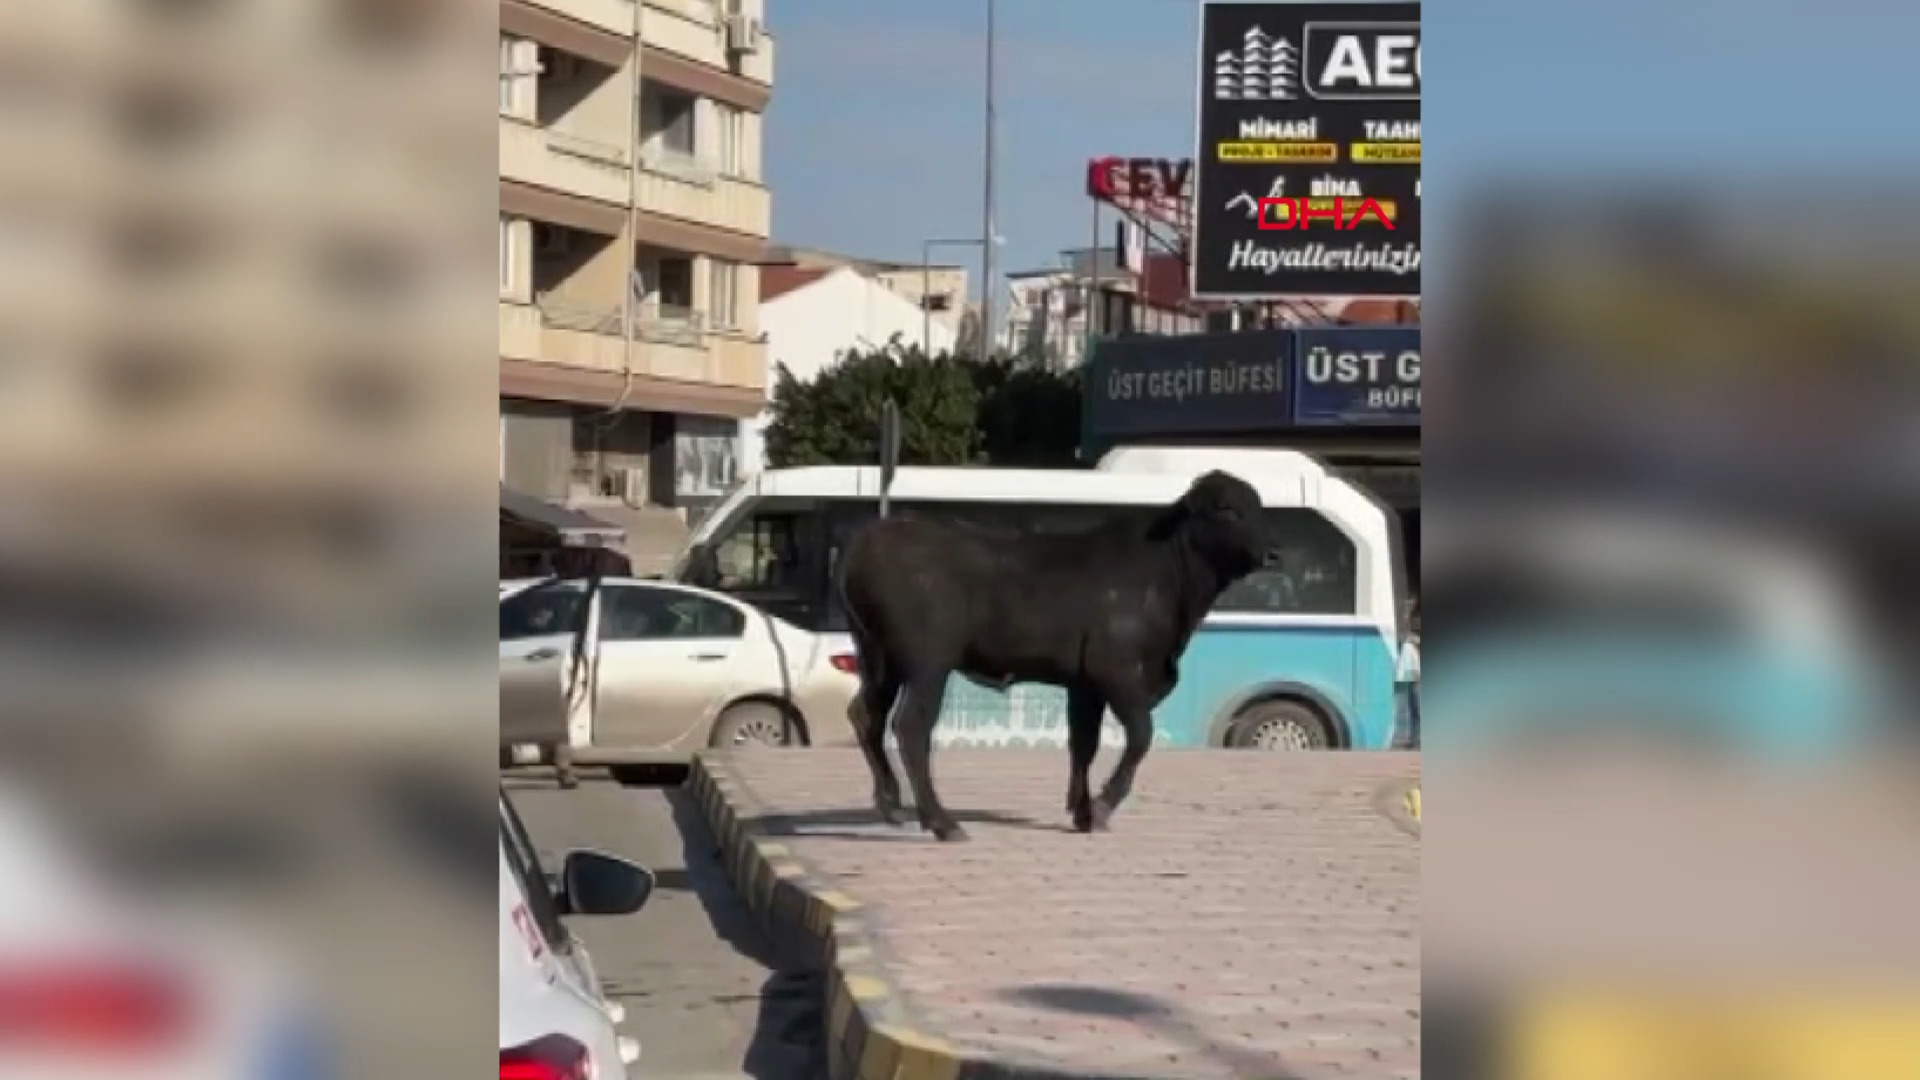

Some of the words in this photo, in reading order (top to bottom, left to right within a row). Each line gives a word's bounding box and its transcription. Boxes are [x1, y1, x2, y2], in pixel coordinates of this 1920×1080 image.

[1320, 35, 1420, 86] AE
[1107, 367, 1145, 400] ÜST
[1148, 361, 1206, 404] GEÇİT
[1210, 357, 1283, 394] BÜFESİ
[1307, 346, 1385, 382] ÜST
